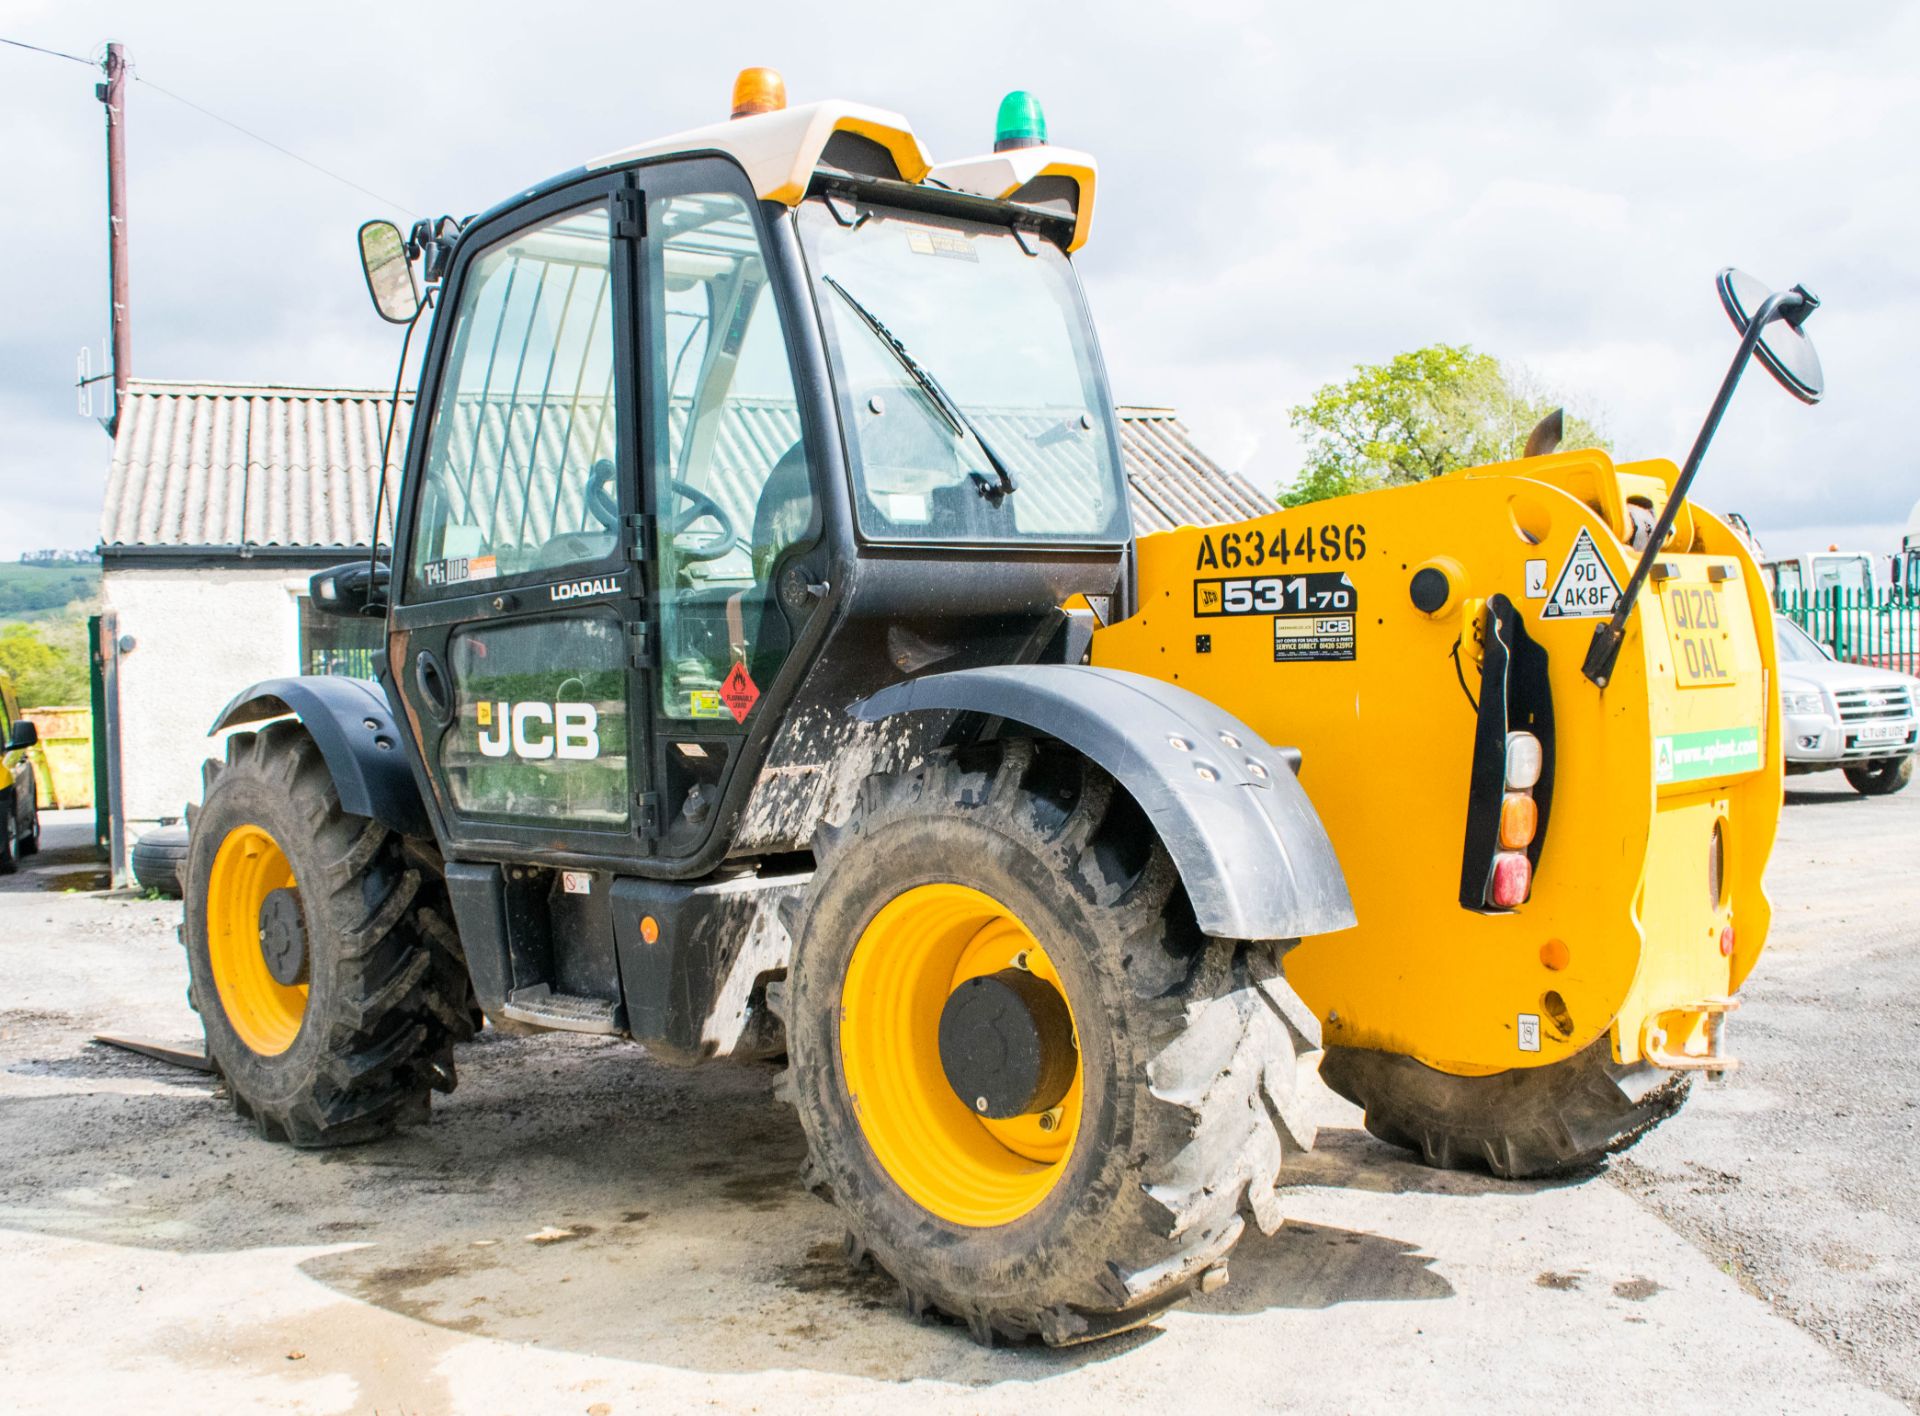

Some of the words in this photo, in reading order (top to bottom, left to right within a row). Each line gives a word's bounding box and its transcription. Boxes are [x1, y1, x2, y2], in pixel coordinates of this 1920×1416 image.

[1196, 524, 1366, 570] A6344S6
[424, 562, 446, 585] T4i
[1574, 563, 1597, 581] 90
[551, 577, 622, 601] LOADALL
[1564, 586, 1611, 606] AK8F
[1671, 589, 1719, 629] Q120
[1317, 620, 1350, 633] JCB
[1298, 642, 1317, 650] DIRECT
[478, 702, 599, 759] JCB
[1674, 738, 1758, 766] www.aplant.com
